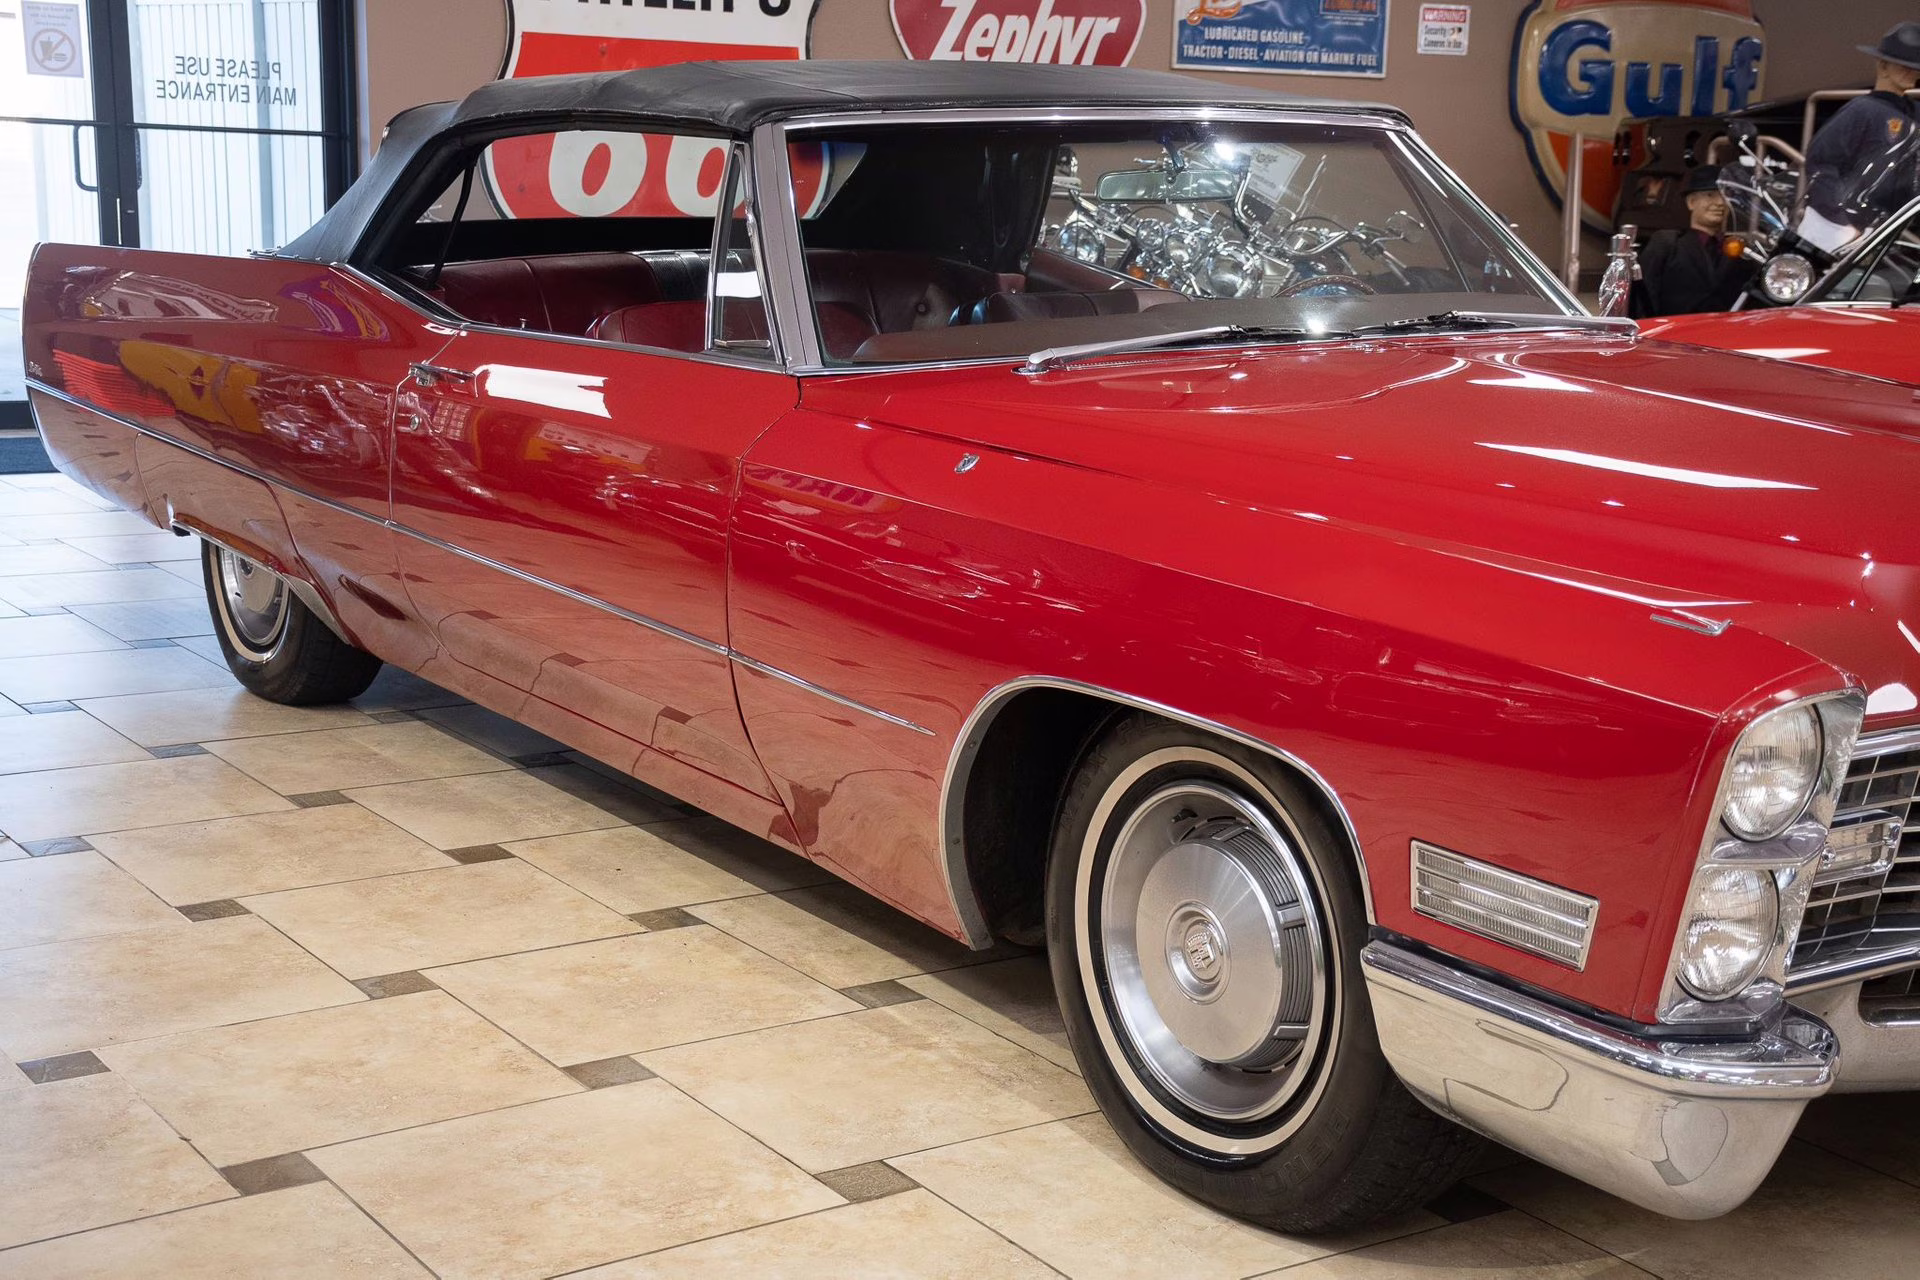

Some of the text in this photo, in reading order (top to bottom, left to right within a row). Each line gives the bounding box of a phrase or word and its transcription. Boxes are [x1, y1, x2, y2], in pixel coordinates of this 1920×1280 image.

[1424, 9, 1466, 22] WARNING
[929, 0, 1122, 65] Zephyr
[1204, 26, 1305, 44] LUBRICATED GASOLINE
[1424, 25, 1447, 38] Security
[1424, 37, 1446, 48] Cameras
[1183, 44, 1224, 58] TRACTOR
[1263, 48, 1305, 63] AVIATION
[1306, 50, 1319, 63] OR
[1320, 50, 1355, 65] MARINE
[1356, 52, 1377, 66] FUEL
[1539, 19, 1763, 119] Gulf
